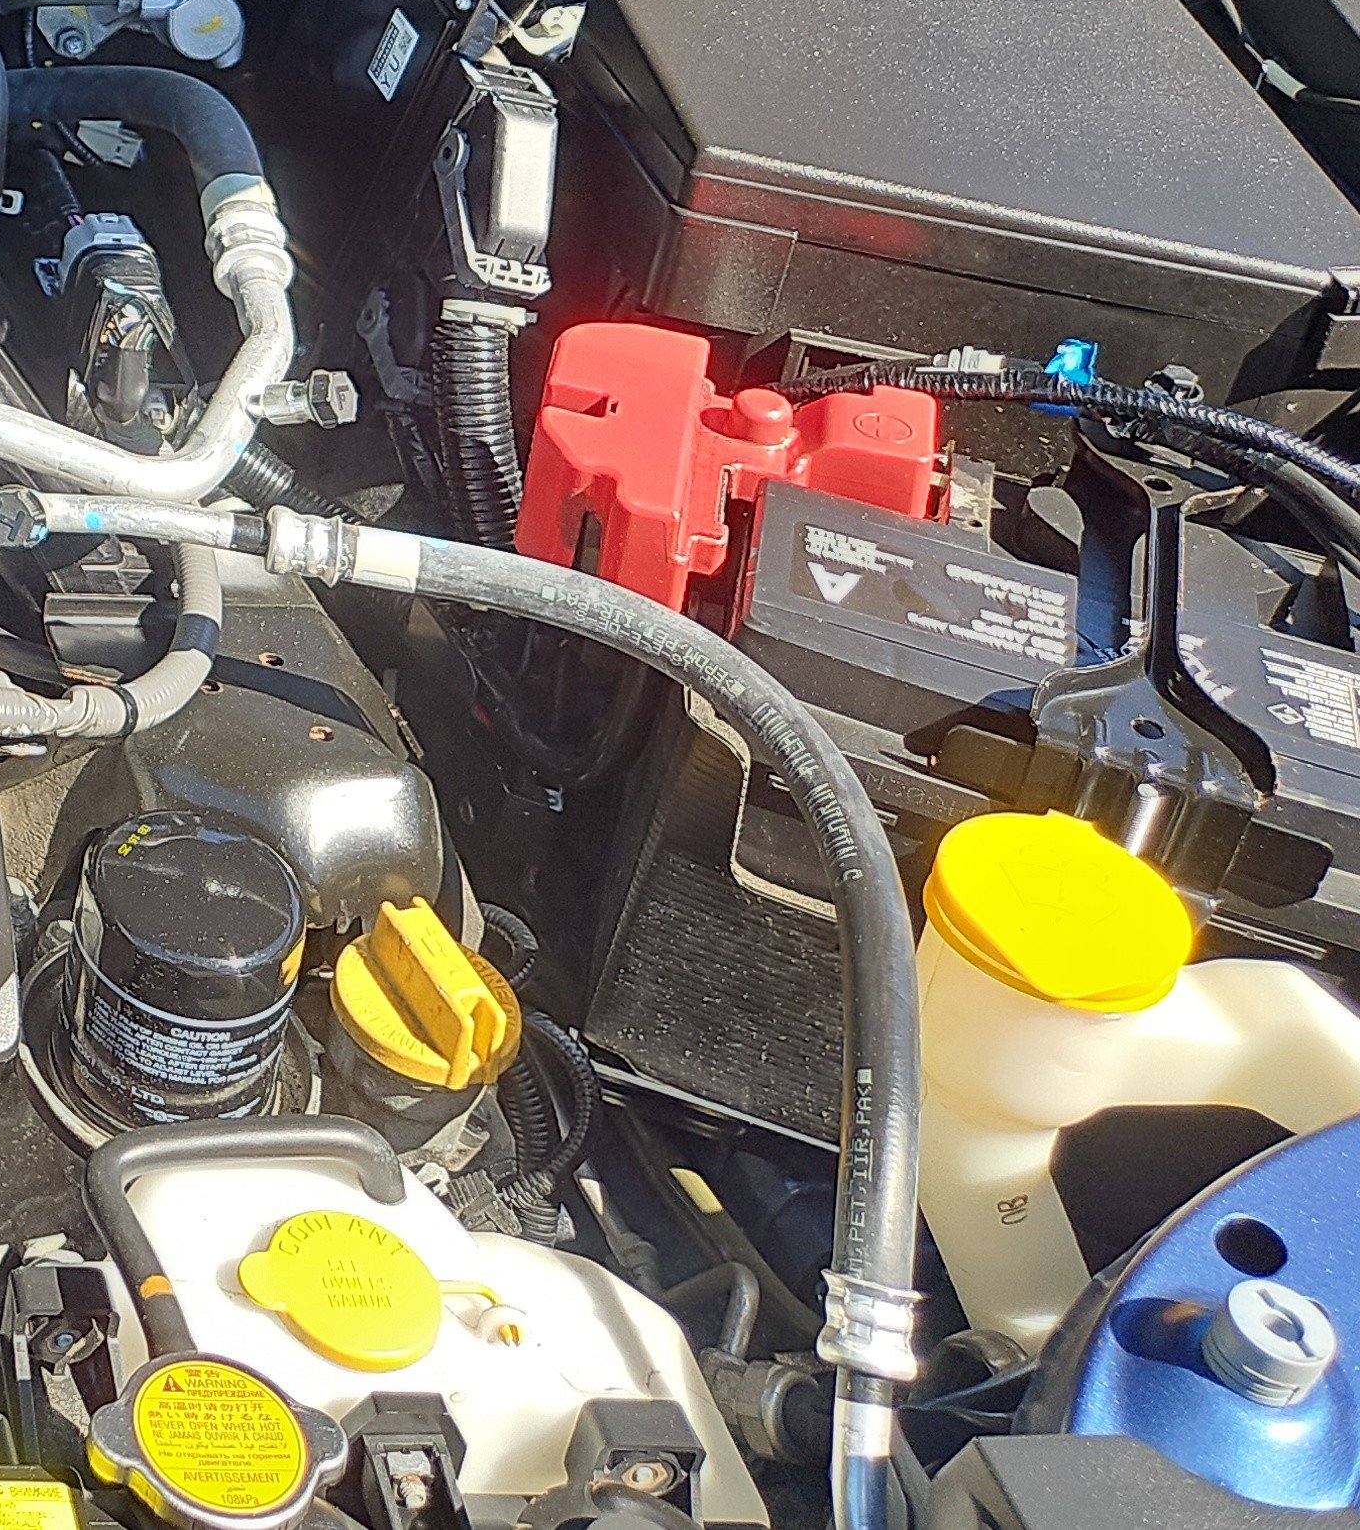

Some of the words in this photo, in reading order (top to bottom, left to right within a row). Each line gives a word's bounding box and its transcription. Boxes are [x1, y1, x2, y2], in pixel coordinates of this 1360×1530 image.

[170, 1027, 231, 1042] CAUTION
[138, 1056, 153, 1067] TO
[184, 1378, 248, 1389] WARNING
[149, 1420, 184, 1430] NEVER
[189, 1421, 219, 1431] OPEN
[223, 1422, 256, 1432] WHEN
[168, 1431, 202, 1441] JAMAIS
[204, 1432, 240, 1441] OUVRIR
[183, 1472, 281, 1484] AVERTISSEMENT
[220, 1493, 260, 1505] 108kPa
